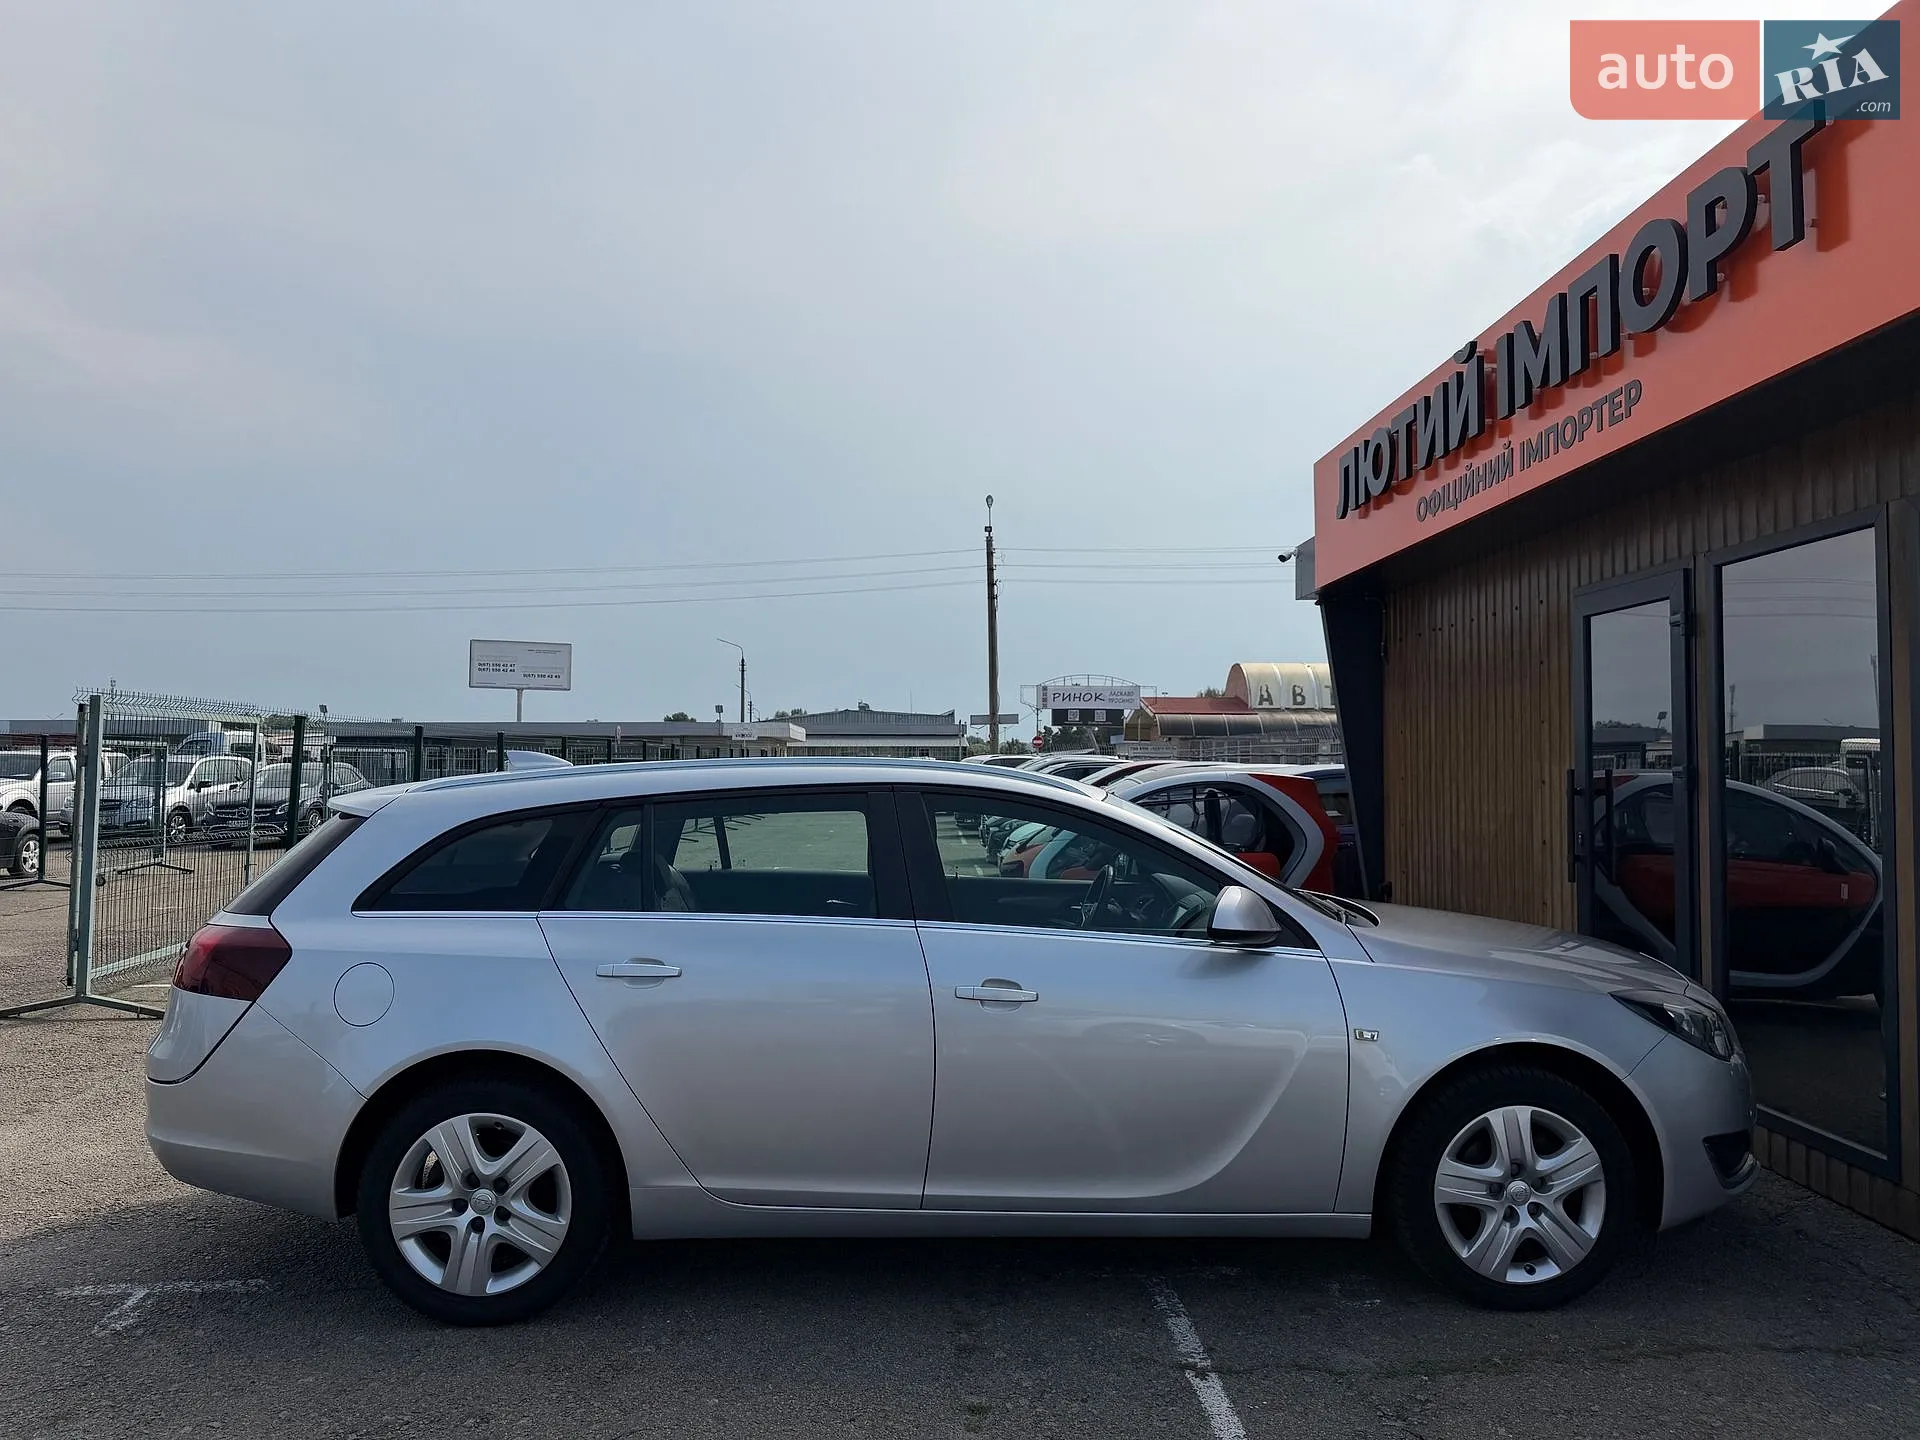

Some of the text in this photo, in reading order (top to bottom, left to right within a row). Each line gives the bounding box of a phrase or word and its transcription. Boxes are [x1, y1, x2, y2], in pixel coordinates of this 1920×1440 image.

[1336, 99, 1826, 519] ЛЮТИЙ ІМПОРТ
[1415, 379, 1643, 522] ОФІЦІЙНИЙ ІМПОРТЕР
[1052, 692, 1105, 703] РИНОК
